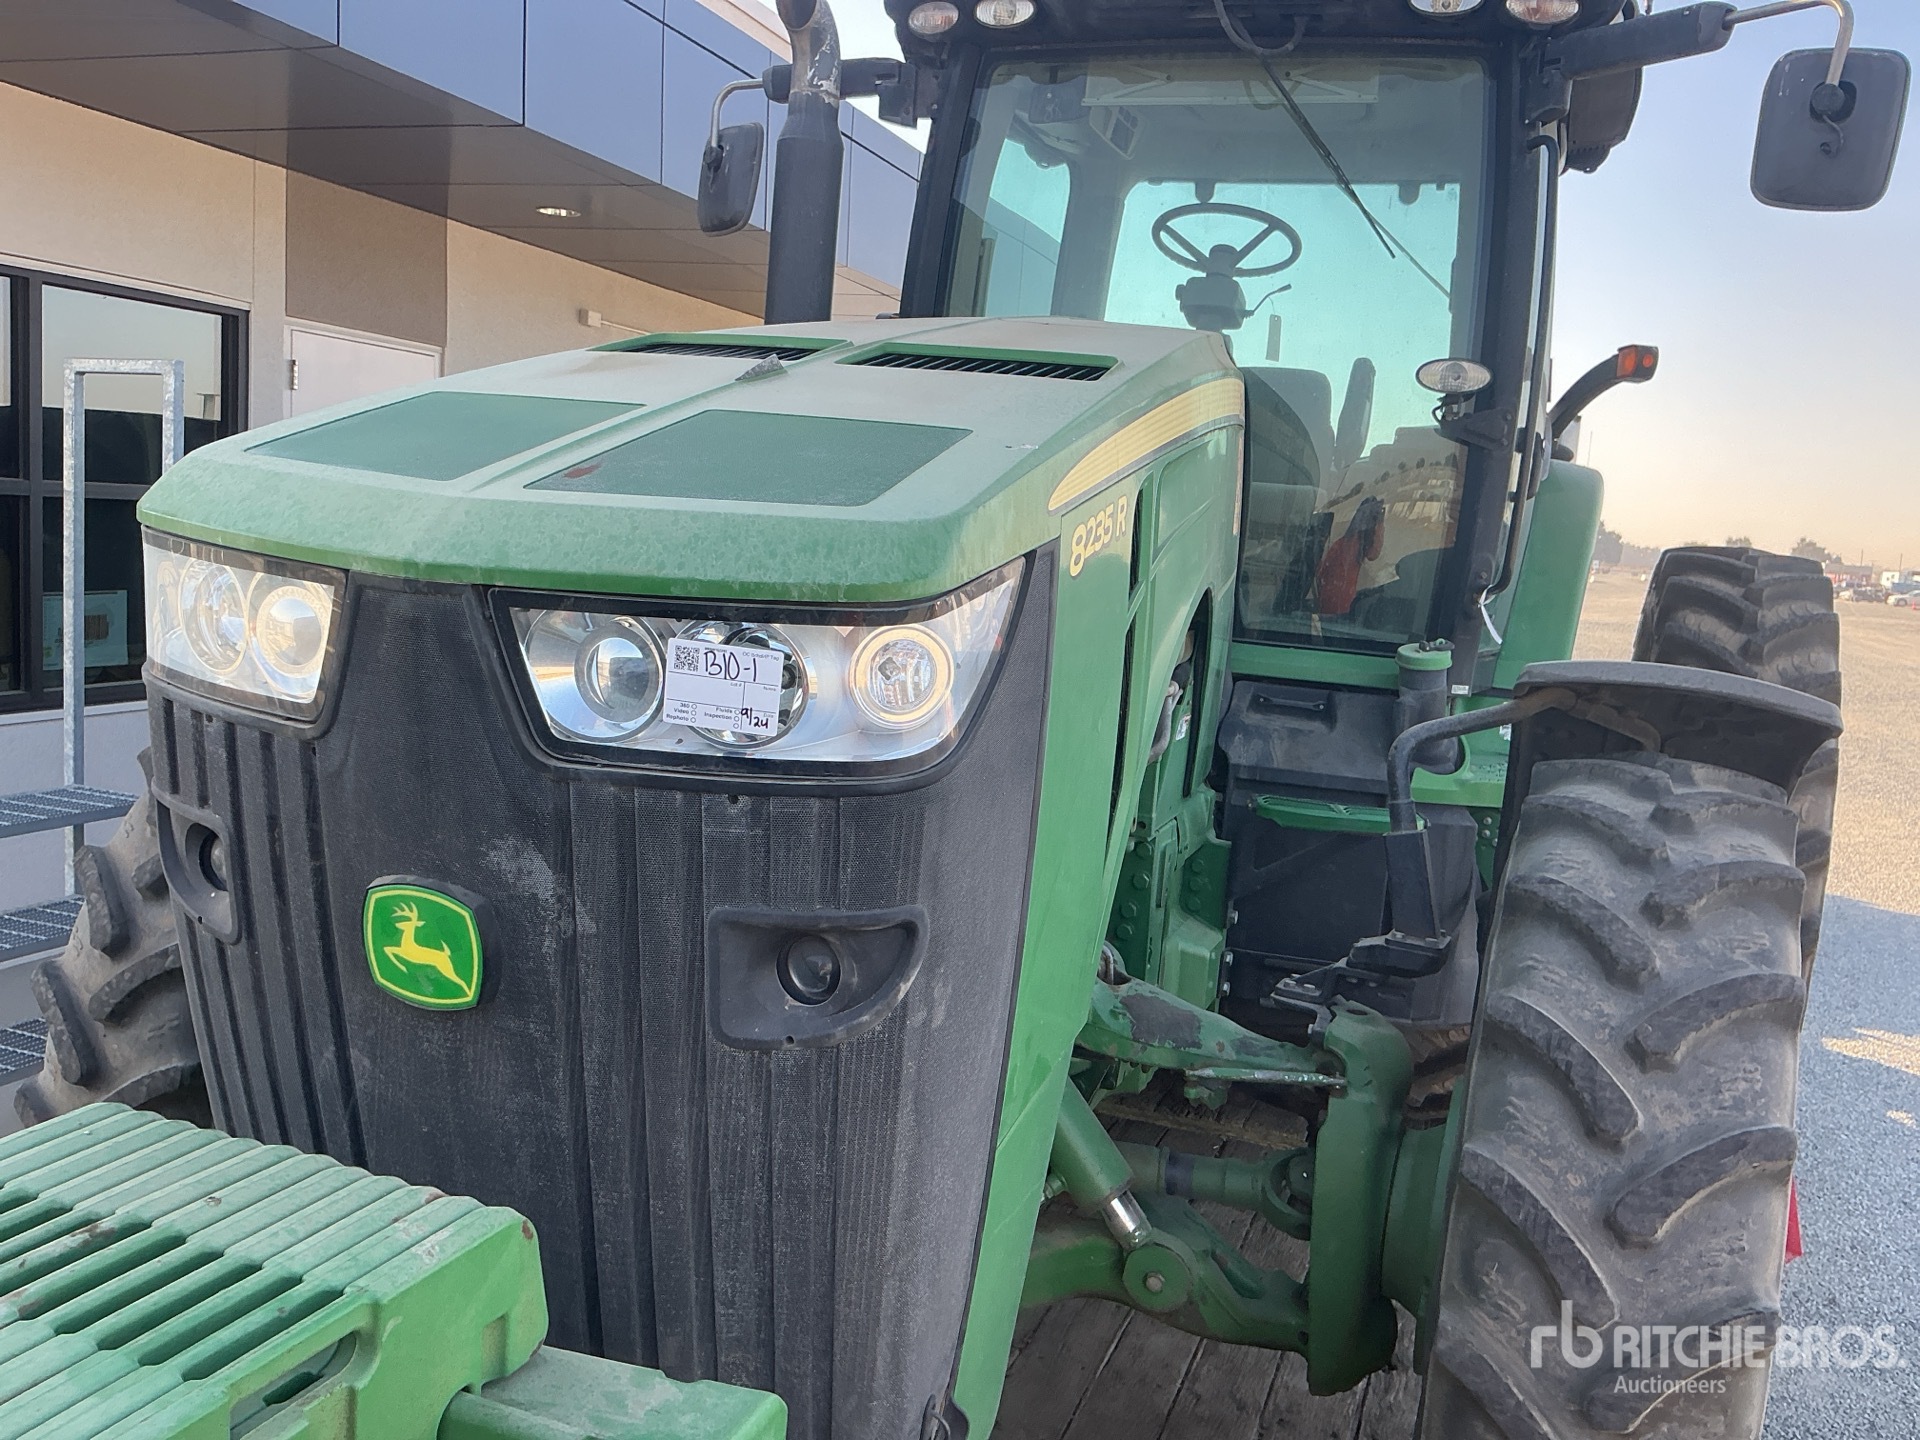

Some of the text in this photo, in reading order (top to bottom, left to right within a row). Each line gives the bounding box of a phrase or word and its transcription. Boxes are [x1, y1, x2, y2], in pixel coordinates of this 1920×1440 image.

[1070, 495, 1128, 577] 8235 R
[704, 650, 757, 682] B10-1
[704, 712, 732, 720] Inspection
